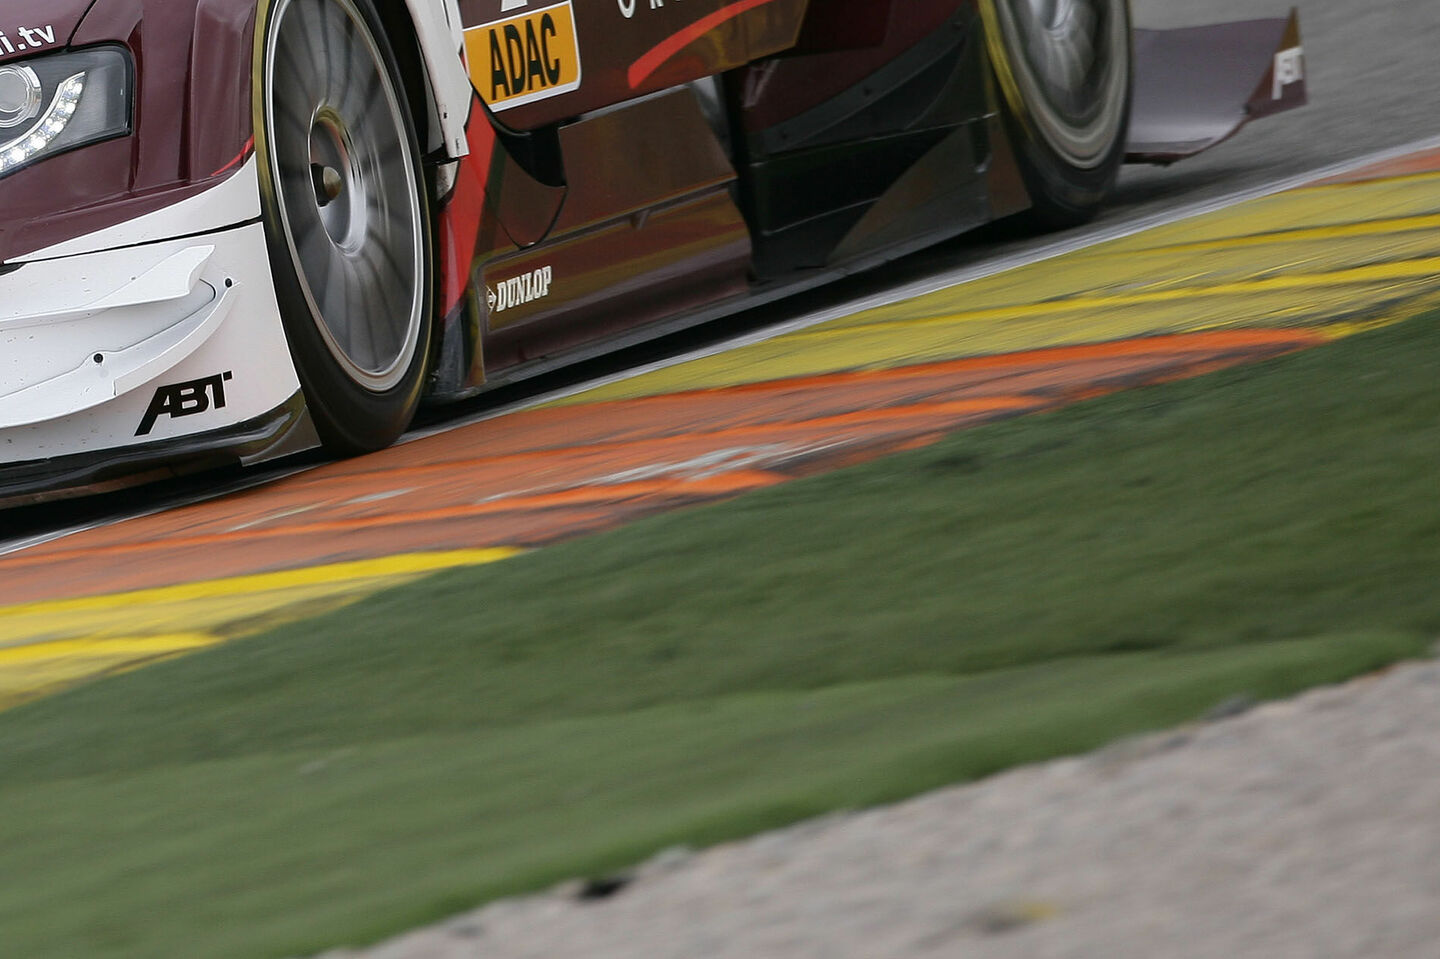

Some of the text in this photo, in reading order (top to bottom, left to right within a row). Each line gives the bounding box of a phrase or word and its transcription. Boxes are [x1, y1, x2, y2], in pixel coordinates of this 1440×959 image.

[488, 12, 561, 102] ADAC
[495, 265, 553, 313] DUNLOP
[134, 370, 233, 437] ABT
